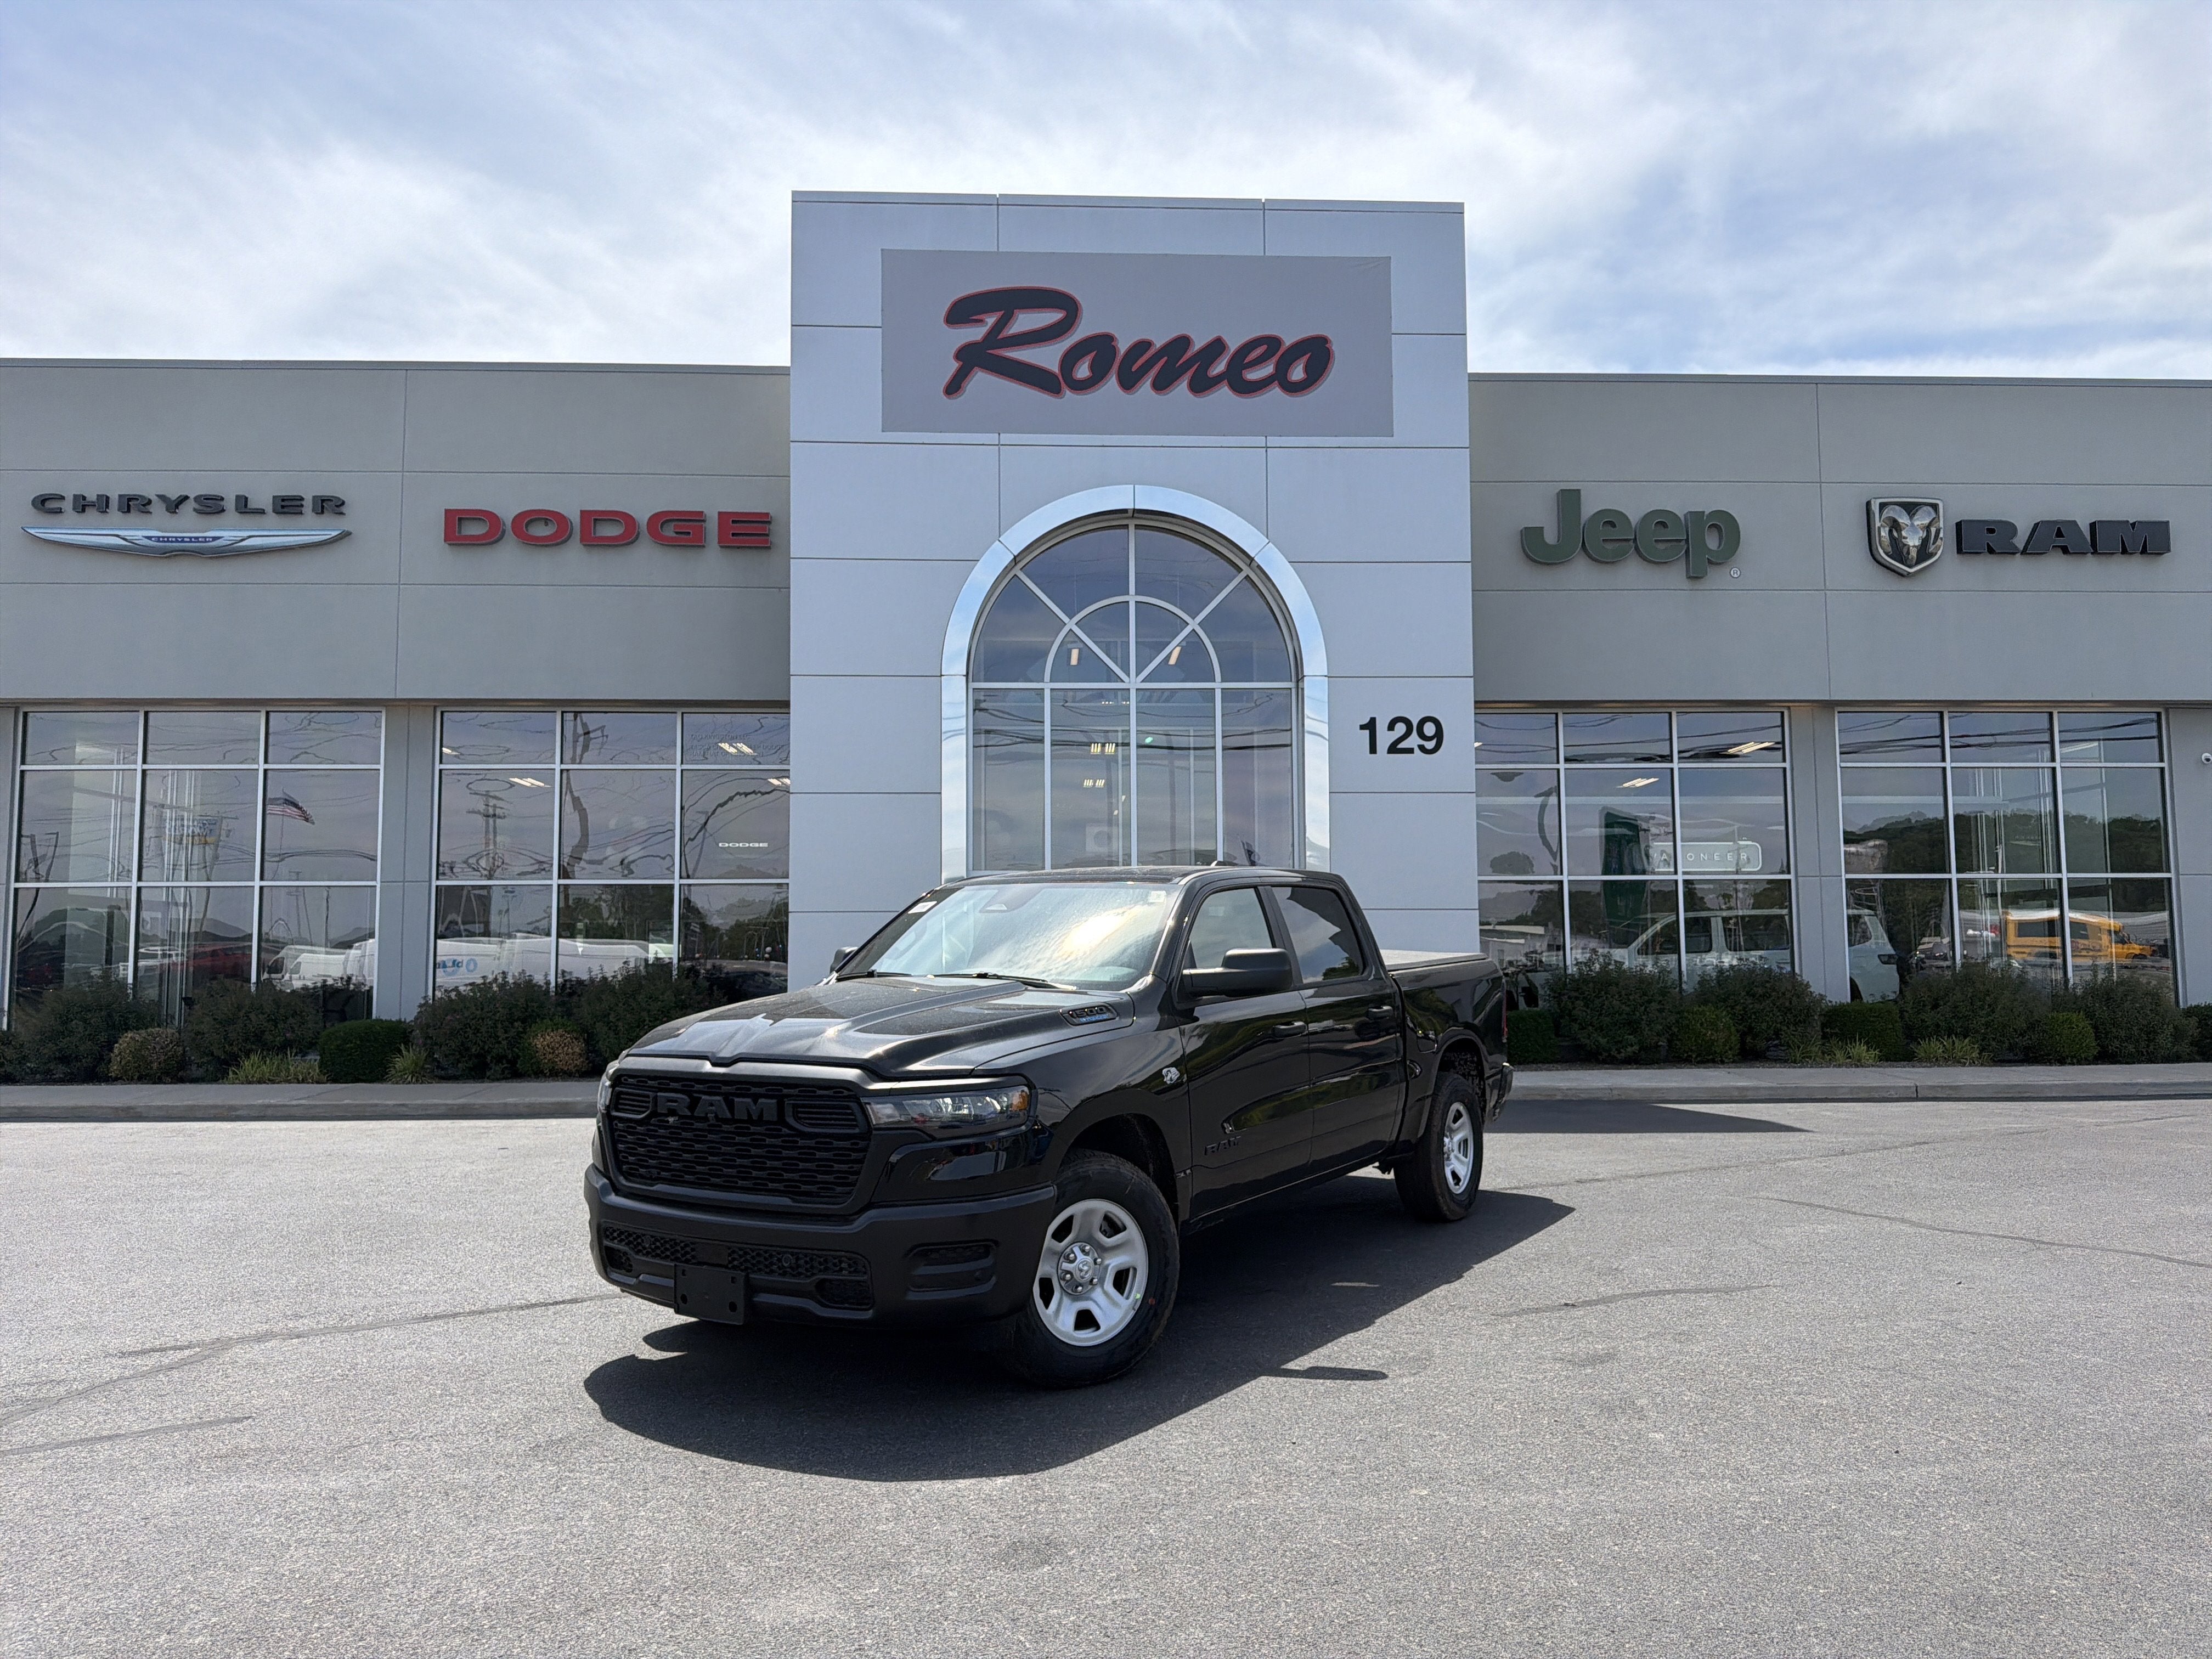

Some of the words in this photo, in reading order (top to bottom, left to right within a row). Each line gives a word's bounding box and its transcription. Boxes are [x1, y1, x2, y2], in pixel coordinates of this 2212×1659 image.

[944, 286, 1335, 399] Romeo
[31, 493, 346, 515] CHRYSLER
[444, 509, 772, 548] DODGE
[1521, 489, 1741, 578] Jeep
[1955, 520, 2171, 555] RAM
[1359, 715, 1444, 755] 129
[1649, 853, 1747, 861] AONEER
[1068, 1006, 1107, 1019] 1500
[657, 1092, 778, 1121] RAM
